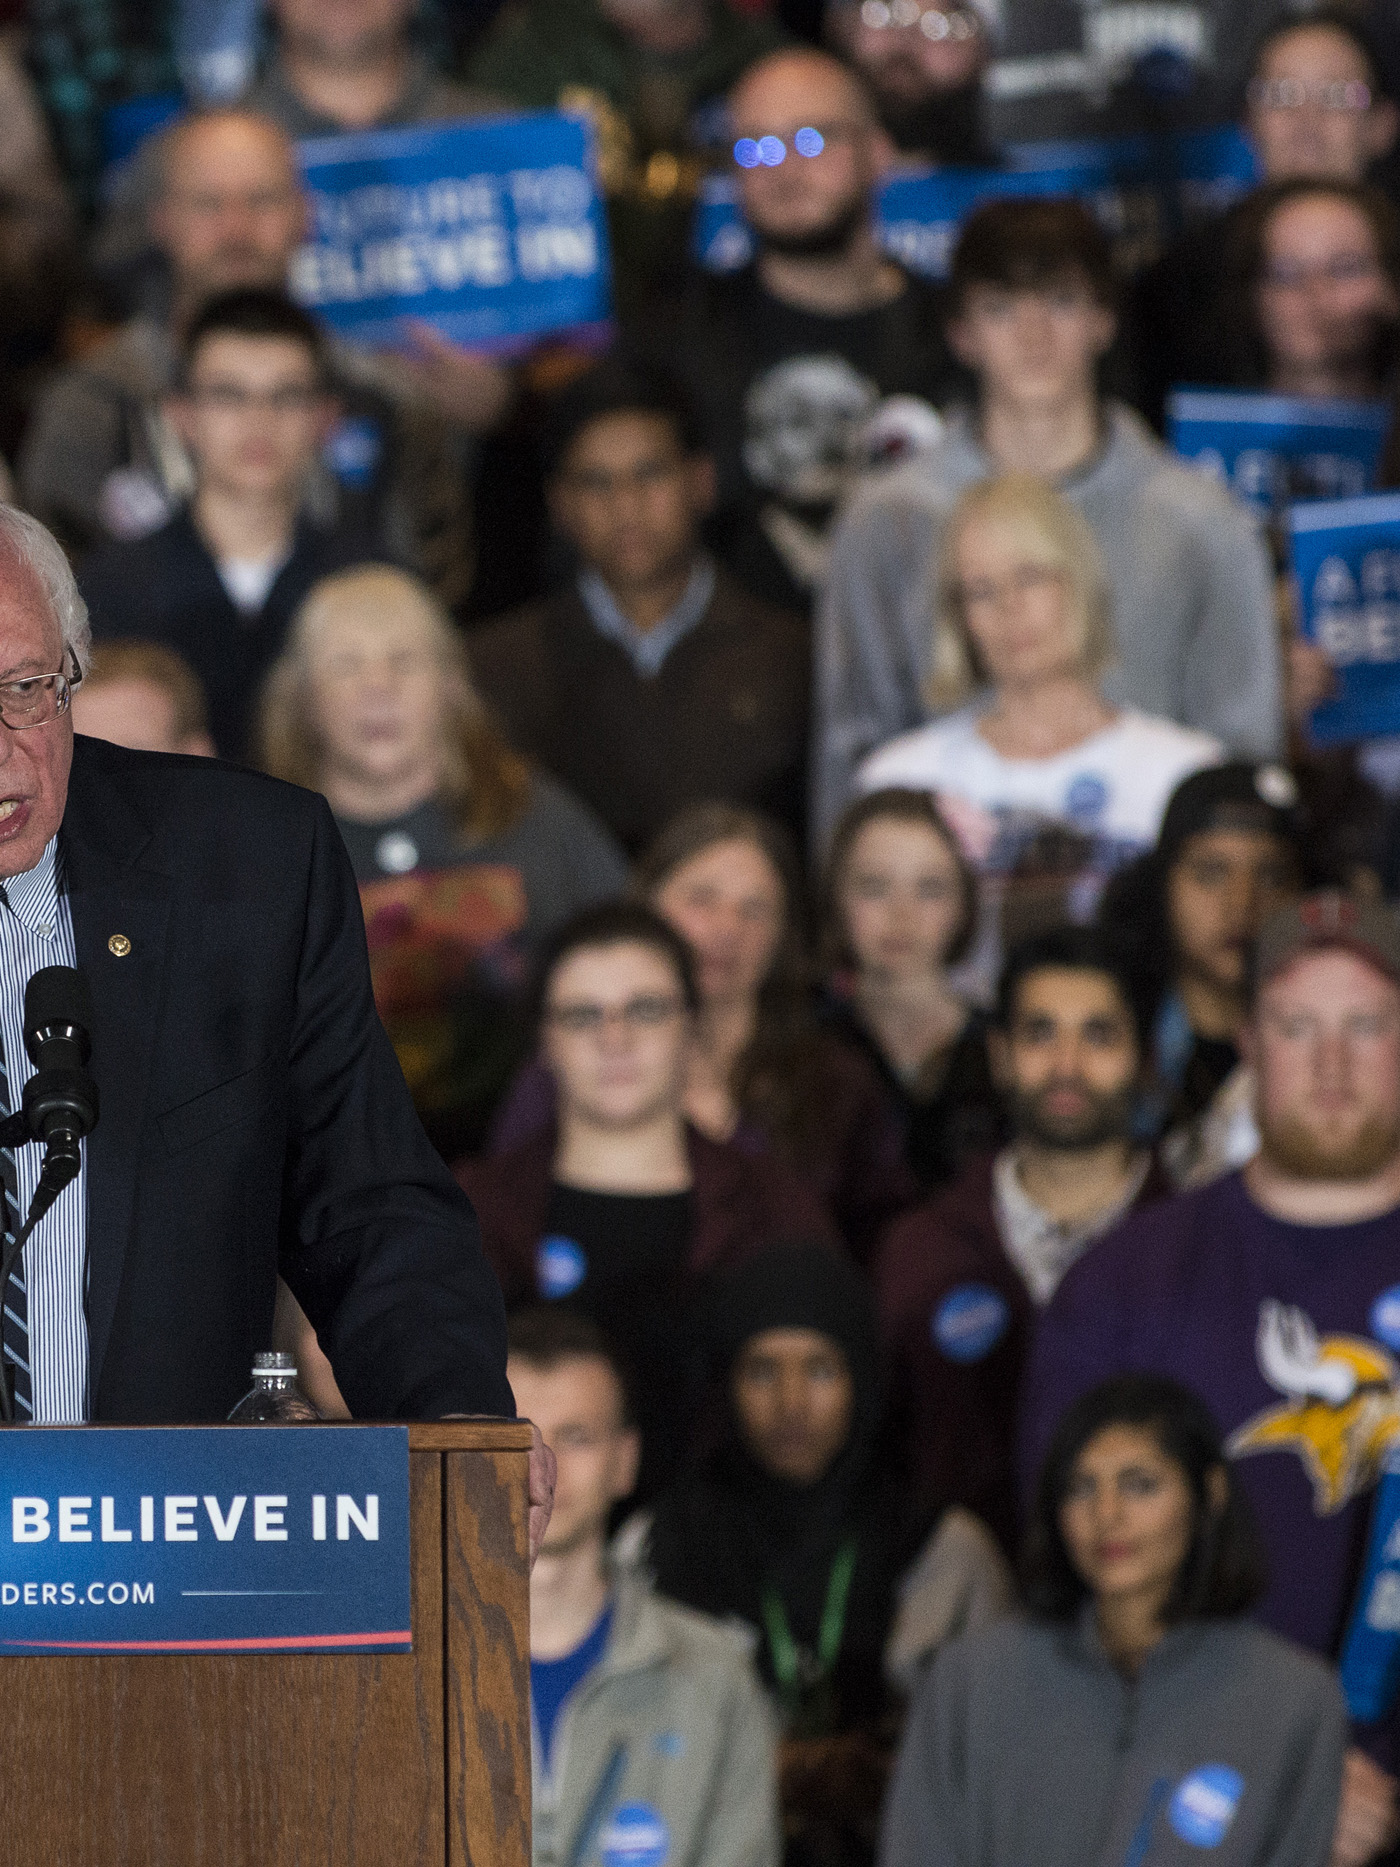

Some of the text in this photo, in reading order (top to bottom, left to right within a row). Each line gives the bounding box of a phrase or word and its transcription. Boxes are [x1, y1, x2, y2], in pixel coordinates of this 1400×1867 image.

[290, 225, 511, 303] ELIEVE
[12, 1495, 288, 1543] BELIEVE
[312, 1494, 379, 1541] IN
